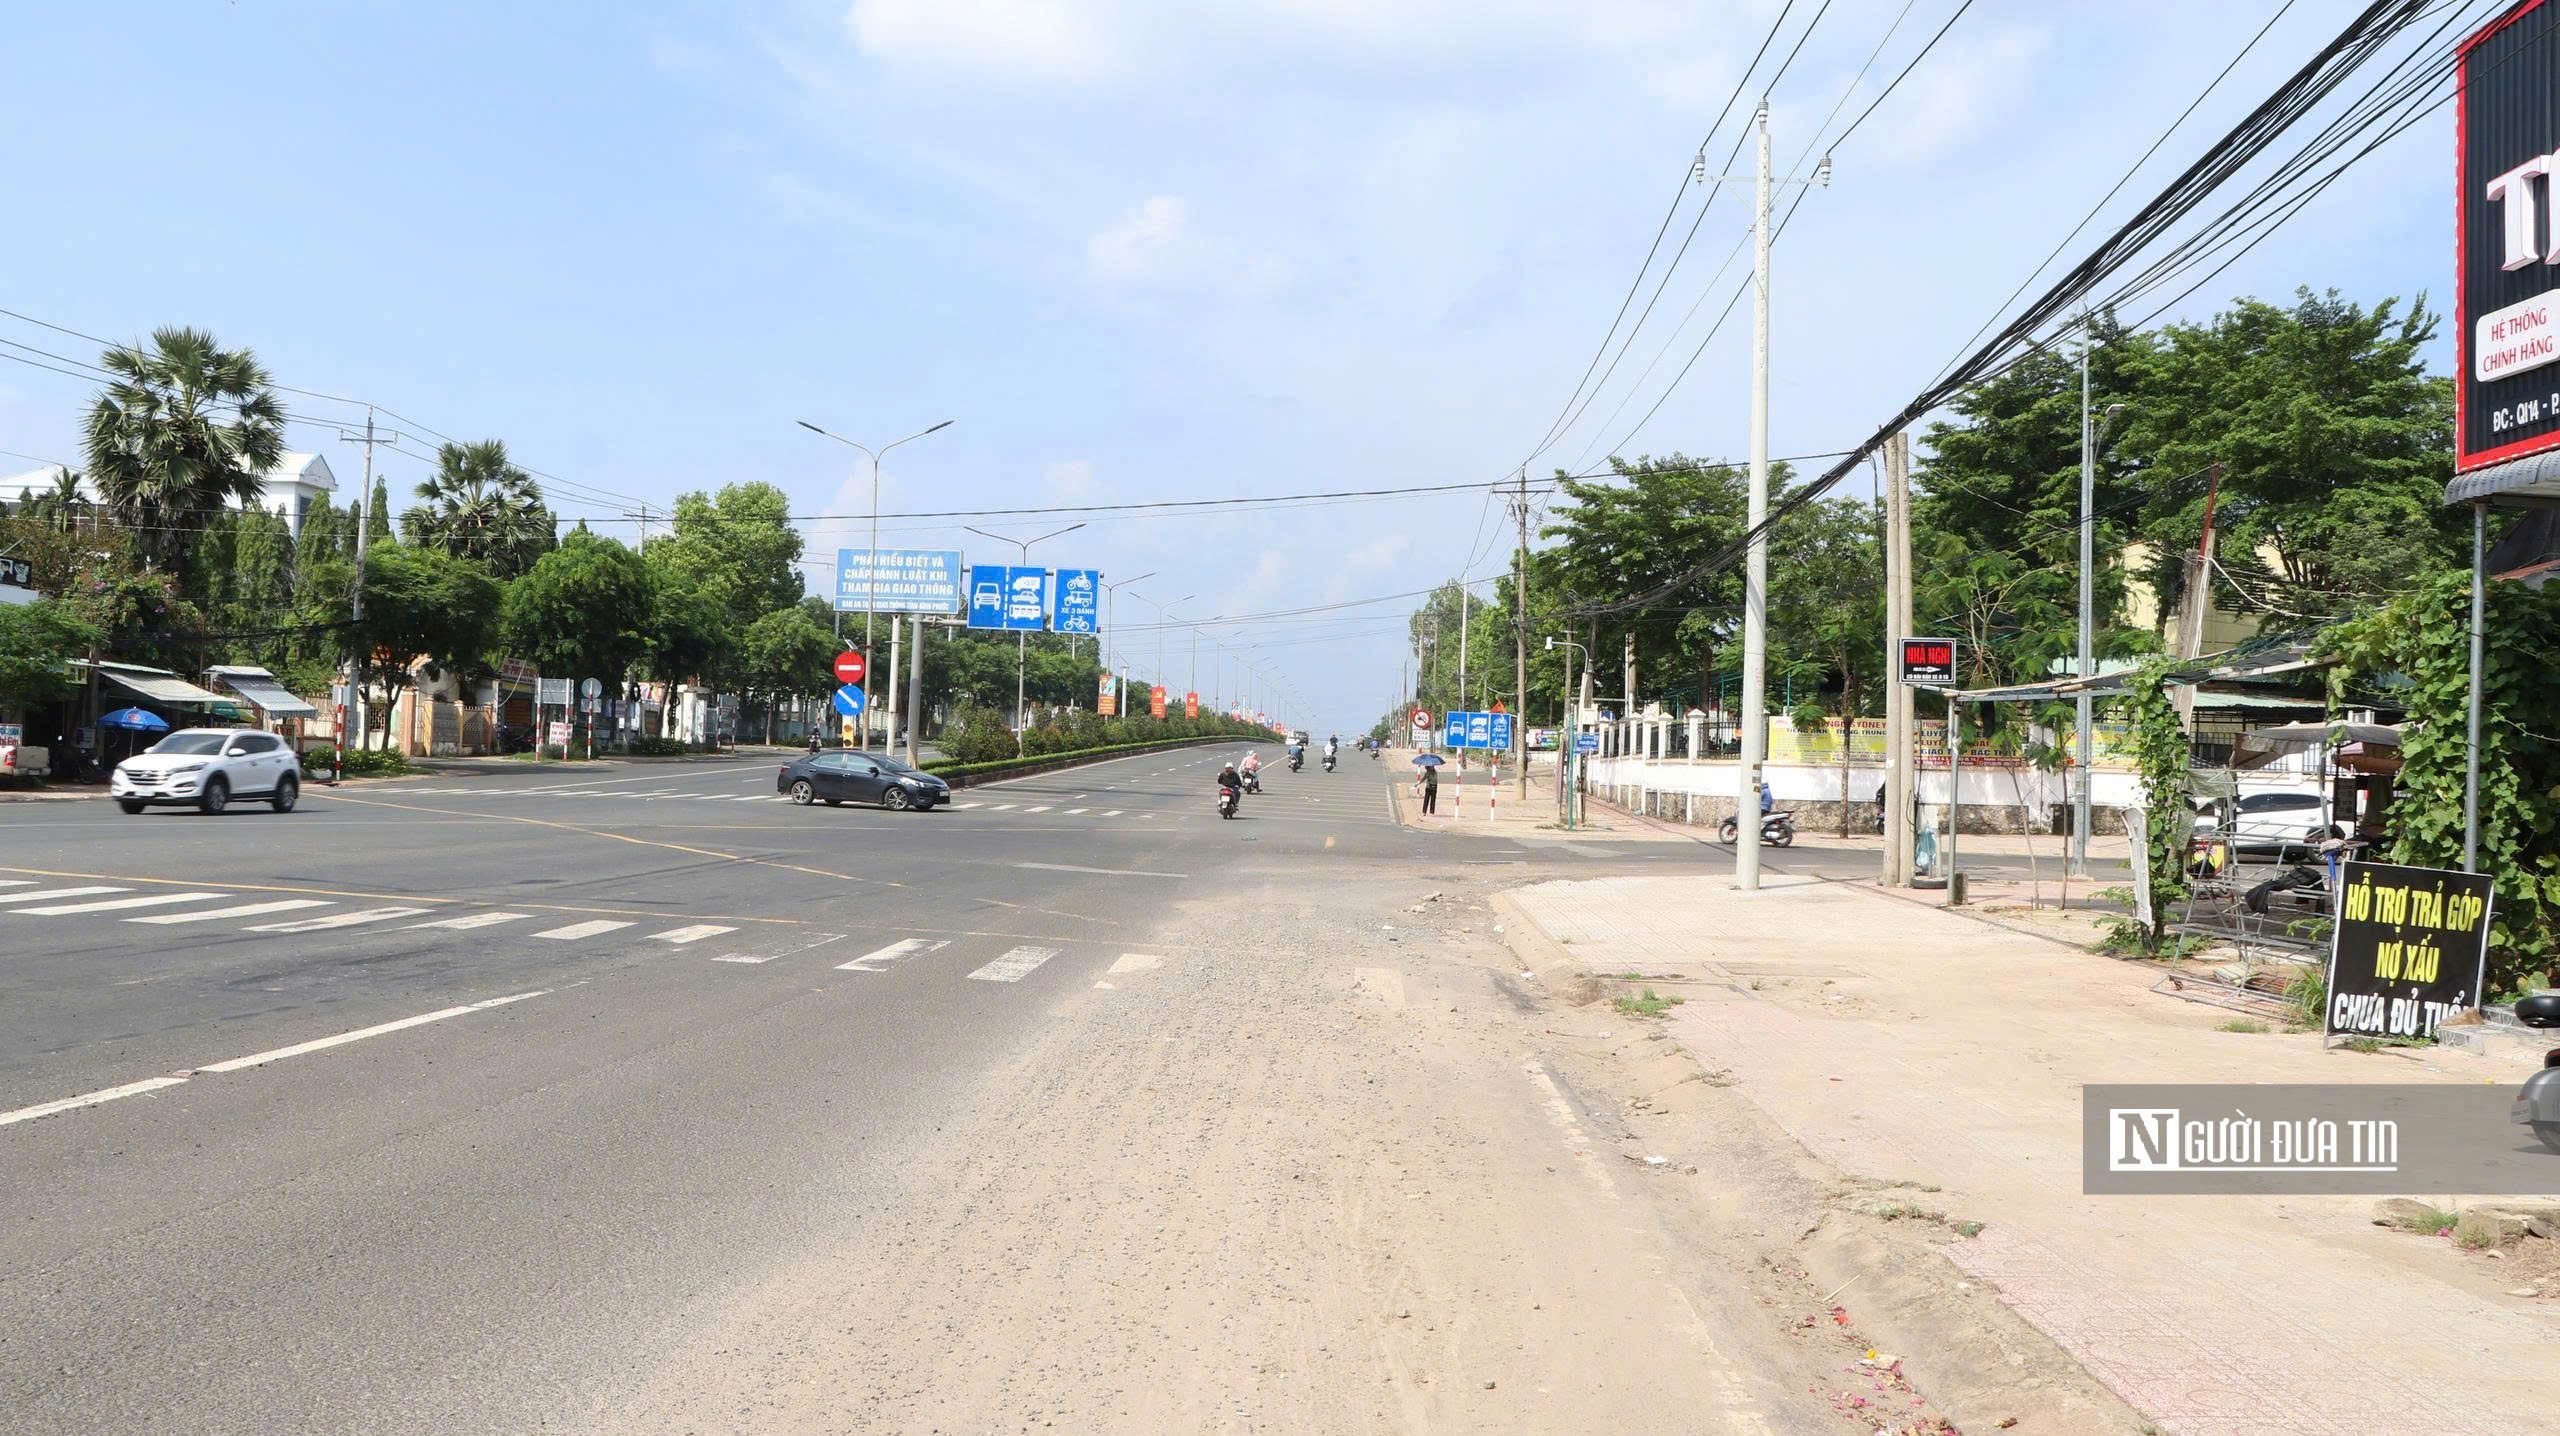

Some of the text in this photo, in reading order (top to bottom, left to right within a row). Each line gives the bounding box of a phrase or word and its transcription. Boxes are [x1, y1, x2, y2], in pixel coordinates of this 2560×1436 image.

[2486, 147, 2560, 271] T
[2491, 306, 2547, 342] HỆ THỐNG
[2483, 335, 2553, 373] CHÍNH HÃNG
[2493, 408, 2514, 433] ĐC:
[902, 568, 927, 583] LUẬT
[929, 570, 947, 581] KHI
[906, 553, 929, 568] BIẾT
[931, 554, 944, 568] VÀ
[842, 582, 953, 595] THAM GIA GIAO THÔNG
[1906, 643, 1926, 665] NHÀ
[2345, 872, 2483, 933] HỖ TRỢ TRẢ GÓP
[2374, 933, 2440, 987] NỢ XẤU
[2333, 987, 2470, 1039] CHƯA ĐỦ TUỔ
